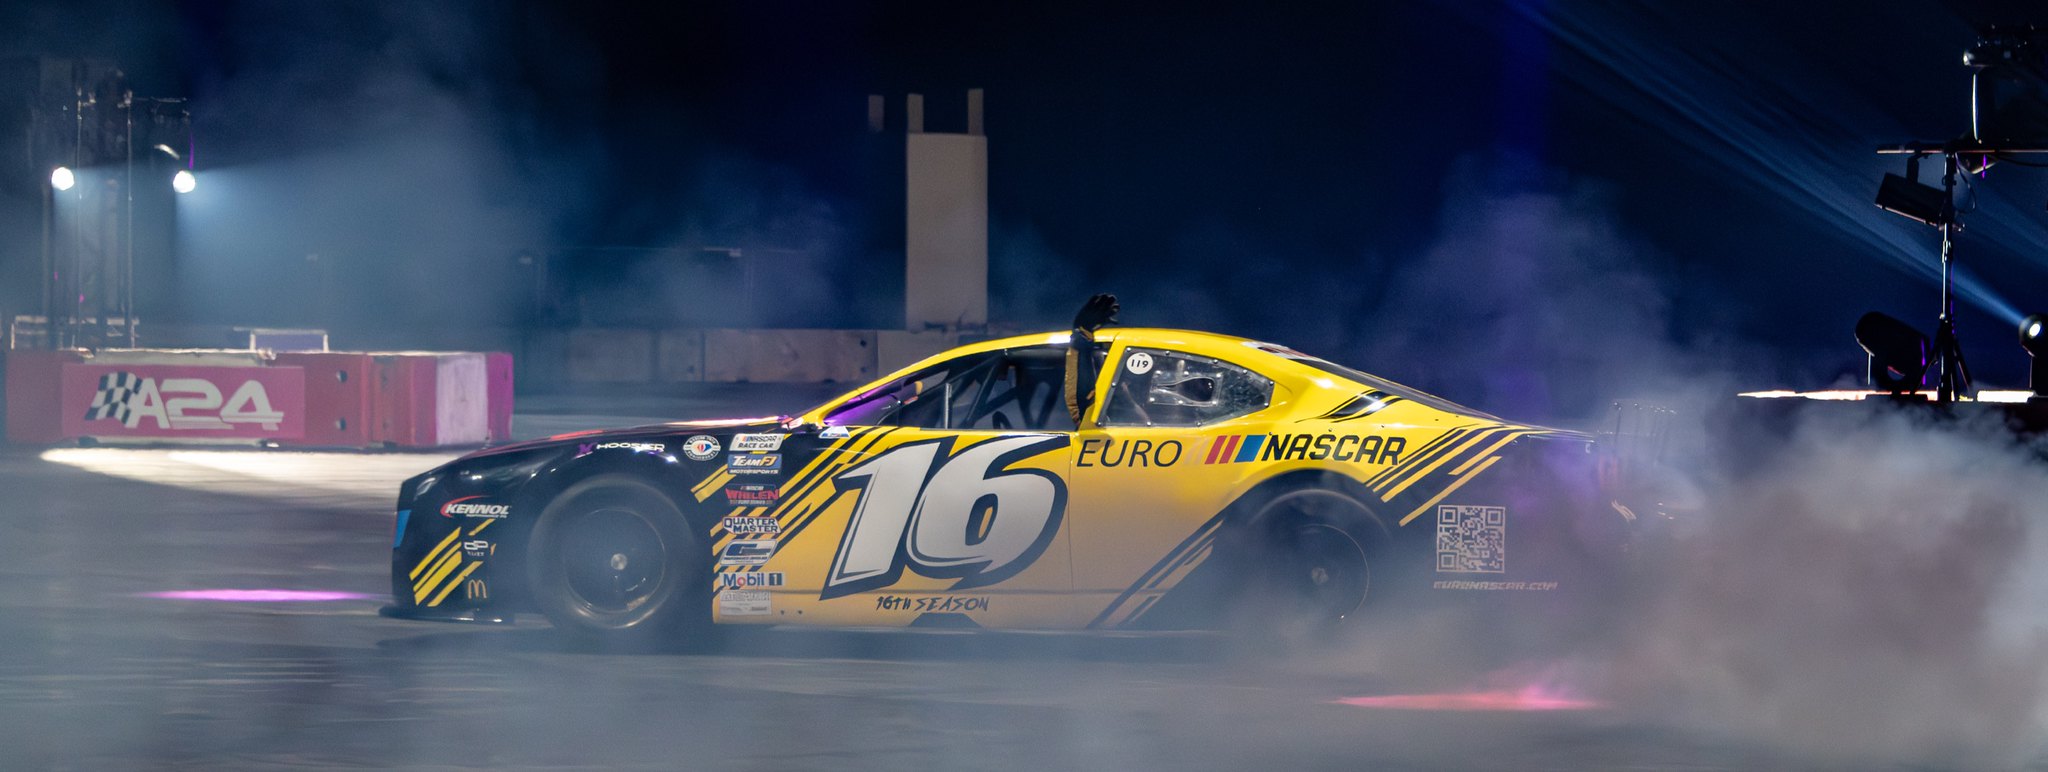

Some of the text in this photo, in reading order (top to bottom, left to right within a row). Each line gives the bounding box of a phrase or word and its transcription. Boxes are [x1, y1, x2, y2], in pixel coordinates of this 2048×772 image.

[1131, 359, 1149, 369] 119
[124, 377, 285, 431] A24
[1075, 433, 1408, 468] EURO NASCAR
[445, 503, 510, 515] KENNOL
[724, 518, 775, 528] QUARTER
[819, 433, 1070, 601] 16
[733, 525, 778, 533] MASTER
[723, 573, 765, 587] Mobil
[1433, 581, 1559, 591] EURONASCAR.COM
[876, 595, 990, 612] 16TH SEASON
